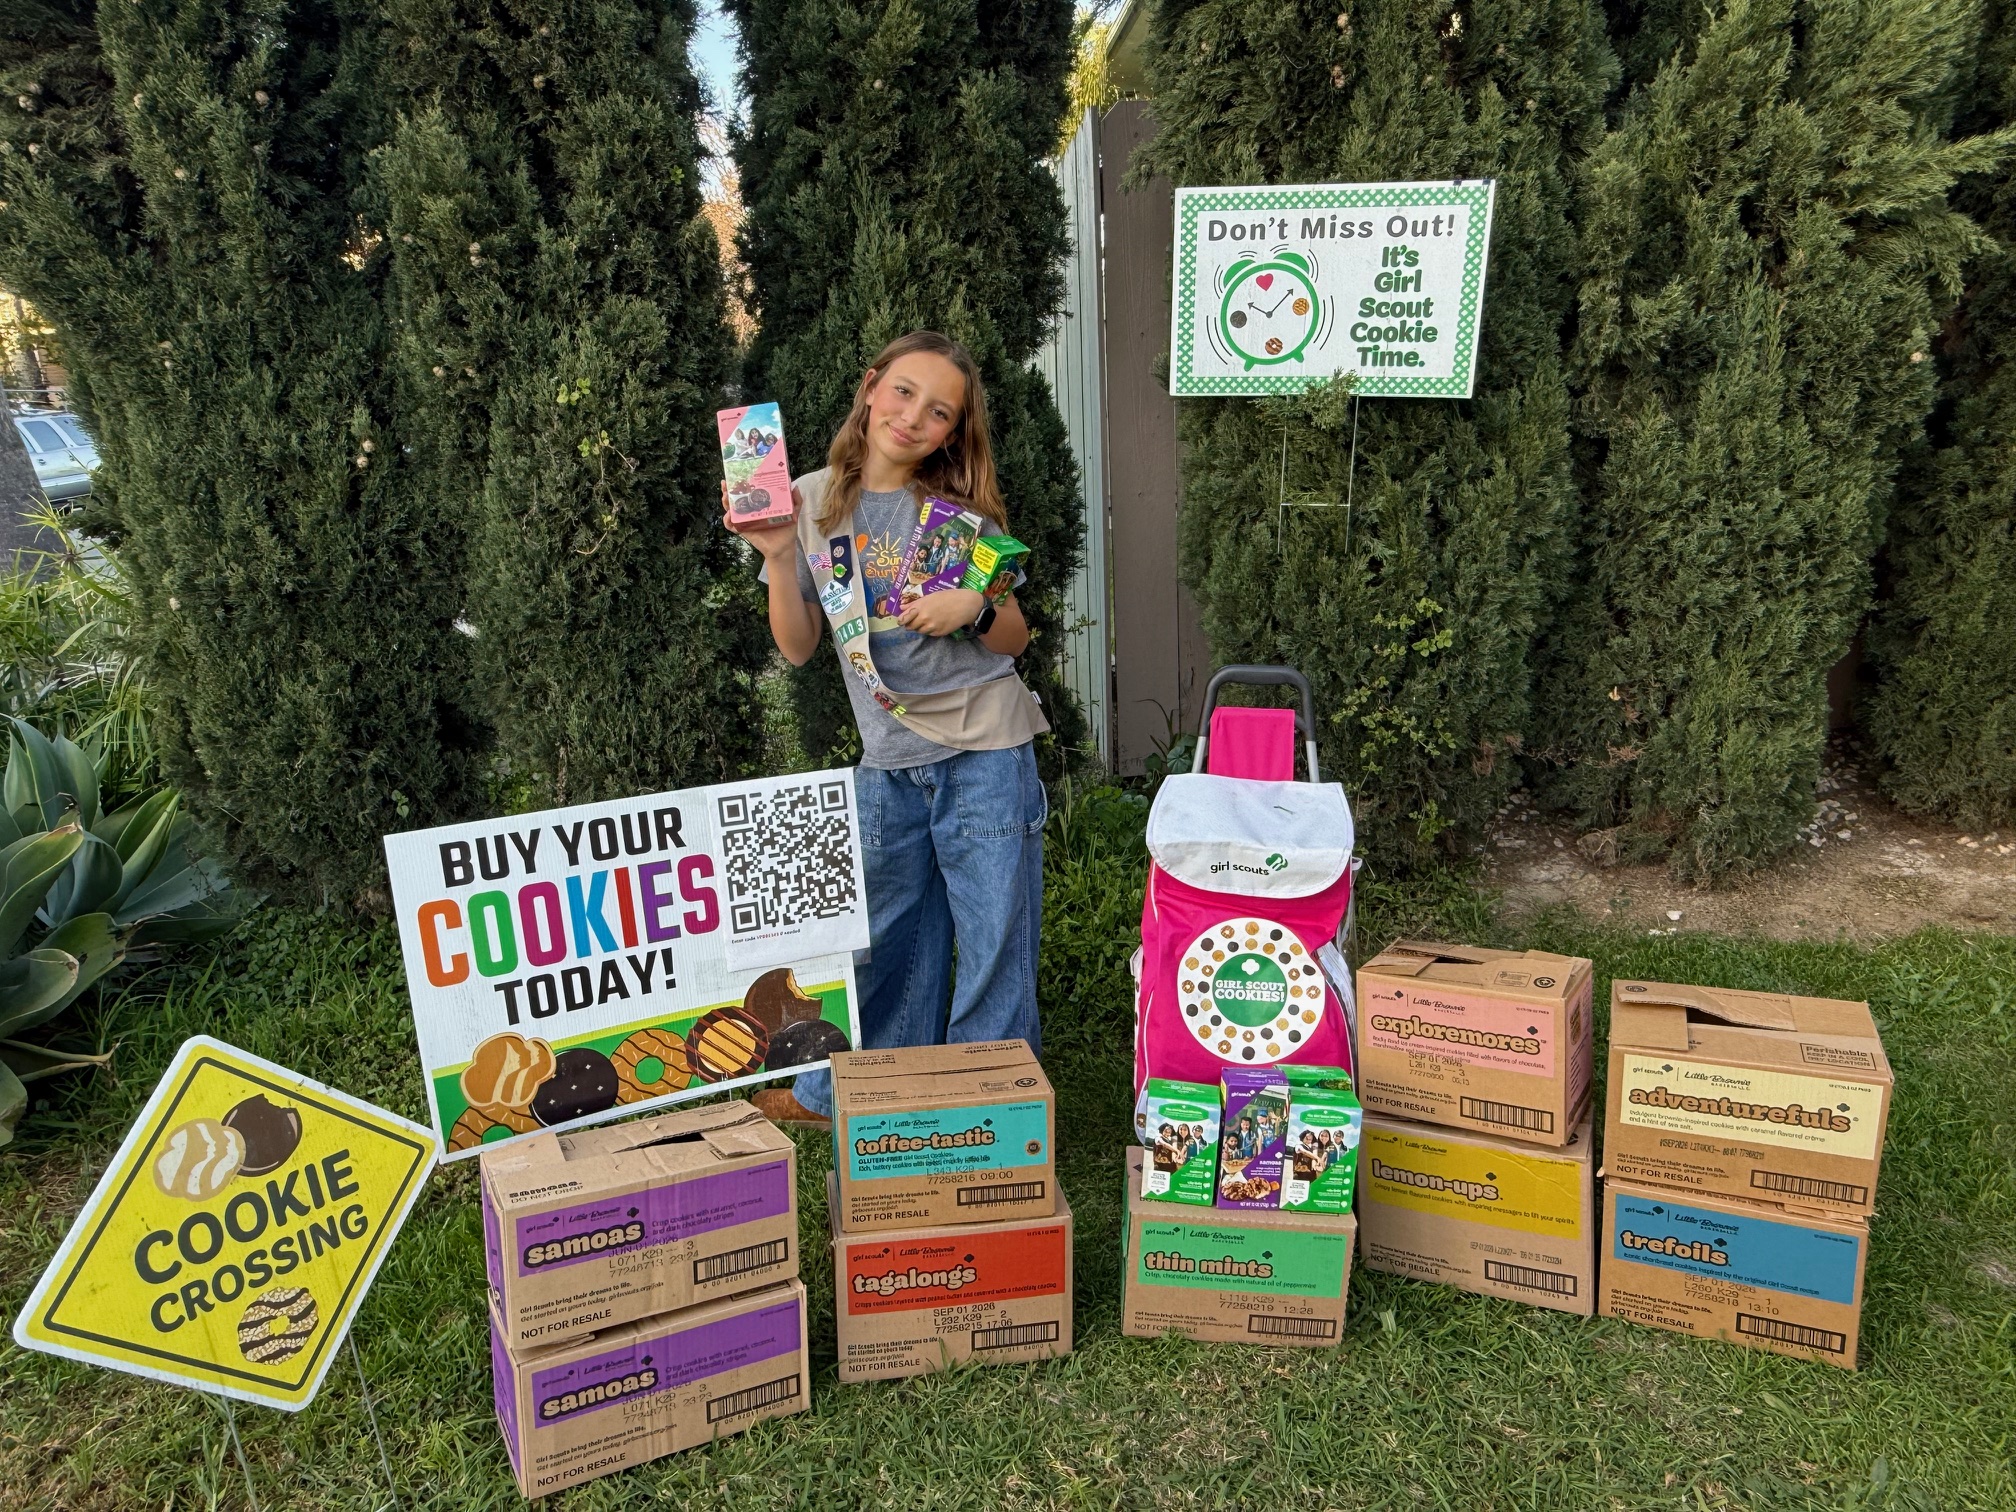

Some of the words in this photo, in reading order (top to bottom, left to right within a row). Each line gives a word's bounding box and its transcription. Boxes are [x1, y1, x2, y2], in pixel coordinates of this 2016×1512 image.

[1209, 217, 1288, 240] Don't
[1300, 215, 1373, 239] Miss
[1386, 215, 1455, 237] Out!
[1382, 244, 1419, 268] It's
[1374, 270, 1422, 293] Girl
[1358, 297, 1433, 318] Scout
[1350, 320, 1438, 343] Cookie
[1356, 346, 1425, 367] Time.
[439, 828, 541, 888] BUY
[552, 806, 687, 867] YOUR
[1210, 861, 1229, 873] girl
[1233, 864, 1269, 875] scouts
[417, 853, 720, 988] COOKIES
[494, 948, 677, 1026] TODAY!
[1215, 989, 1285, 1002] COOKIES!
[1216, 980, 1243, 989] GIRL
[1246, 982, 1285, 991] SCOUT
[1372, 1014, 1539, 1055] exploremores
[1805, 1045, 1868, 1058] Perishable
[1366, 1094, 1383, 1104] NOT
[1385, 1098, 1401, 1107] FOR
[1404, 1101, 1435, 1113] RESALE
[1629, 1087, 1851, 1132] adventurefuls
[855, 1127, 994, 1154] toffee-tastic
[928, 1173, 974, 1184] 77258216
[980, 1170, 1013, 1180] 09:00
[1372, 1158, 1498, 1200] lemon-ups
[1616, 1165, 1637, 1173] NOT
[1640, 1168, 1660, 1177] FOR
[1663, 1172, 1702, 1184] RESALE
[134, 1149, 360, 1284] COOKIE
[852, 1214, 871, 1222] NOT
[874, 1212, 892, 1220] FOR
[895, 1209, 929, 1218] RESALE
[525, 1221, 643, 1267] samoas
[687, 1239, 693, 1249] 3
[1621, 1230, 1727, 1266] trefoils
[150, 1205, 369, 1333] CROSSING
[1144, 1250, 1195, 1271] thin
[1199, 1254, 1273, 1277] mints
[1389, 1258, 1405, 1267] FOR
[1408, 1262, 1439, 1275] RESALE
[853, 1265, 975, 1296] tagalongs
[1717, 1287, 1738, 1298] K29
[933, 1307, 953, 1316] SEP
[957, 1305, 967, 1313] 01
[934, 1316, 958, 1325] L232
[963, 1313, 981, 1322] K29
[1283, 1306, 1313, 1314] 12:28
[1610, 1306, 1631, 1316] NOT
[1634, 1311, 1653, 1321] FOR
[1656, 1316, 1694, 1329] RESALE
[1748, 1302, 1779, 1315] 13:10
[521, 1325, 544, 1339] NOT
[547, 1319, 569, 1332] FOR
[572, 1308, 611, 1326] RESALE
[935, 1322, 982, 1334] 77258215
[848, 1364, 866, 1372] NOT
[868, 1362, 885, 1370] FOR
[888, 1358, 919, 1368] RESALE
[540, 1367, 657, 1420] samoas
[699, 1383, 706, 1392] 3
[537, 1473, 560, 1487] NOT
[563, 1465, 583, 1479] FOR
[587, 1452, 625, 1471] RESALE
